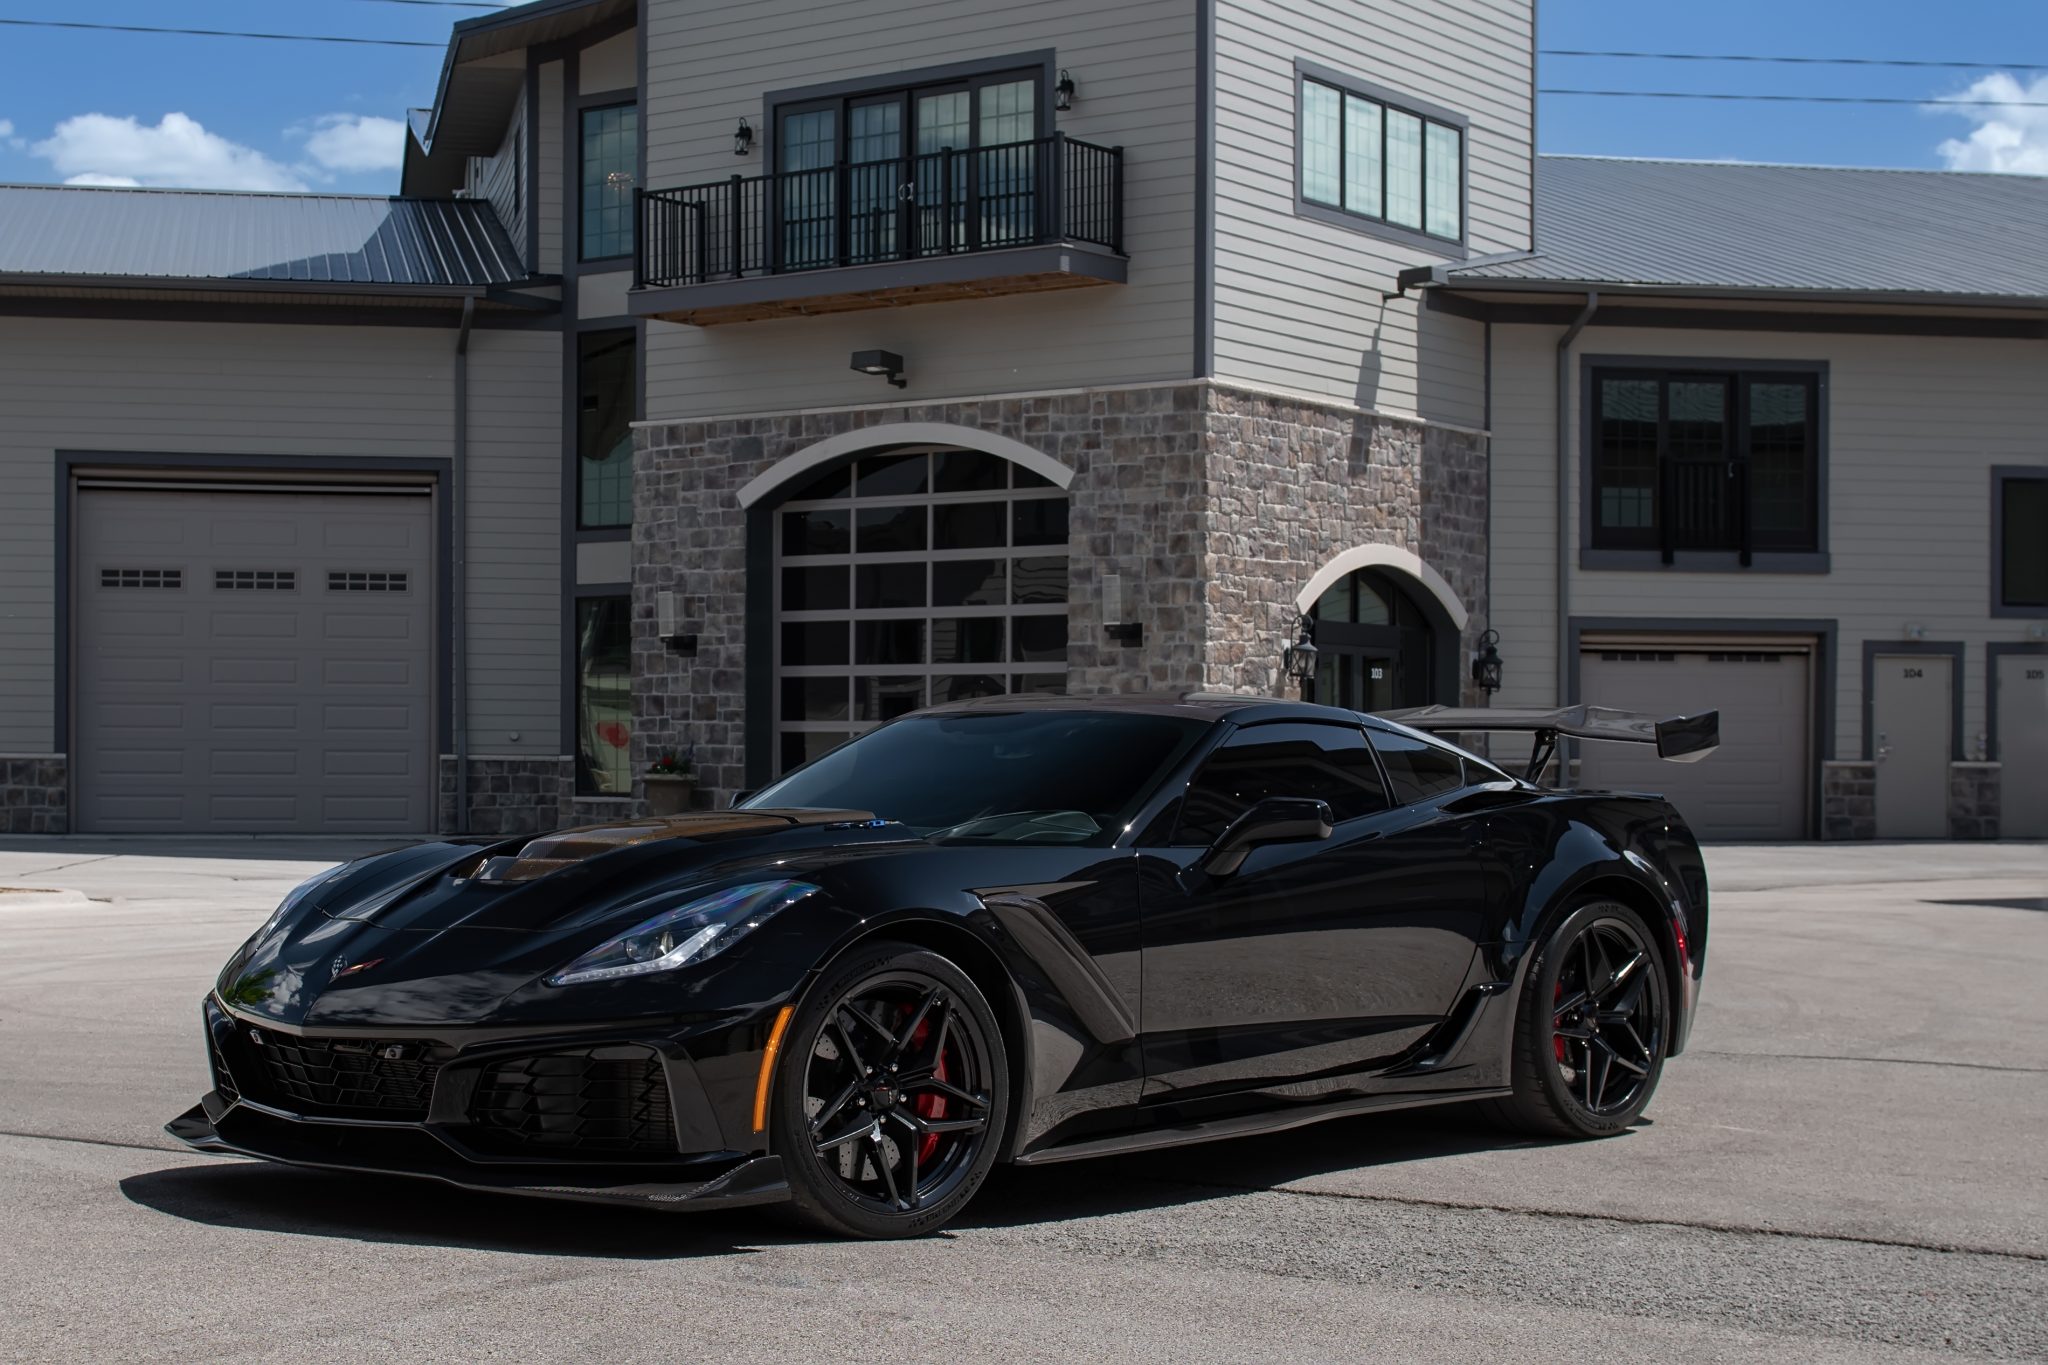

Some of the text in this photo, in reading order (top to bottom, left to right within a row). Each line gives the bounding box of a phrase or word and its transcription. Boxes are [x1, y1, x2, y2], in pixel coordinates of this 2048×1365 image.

[1371, 667, 1383, 679] 103
[1903, 667, 1923, 679] 104
[2025, 669, 2045, 680] 105
